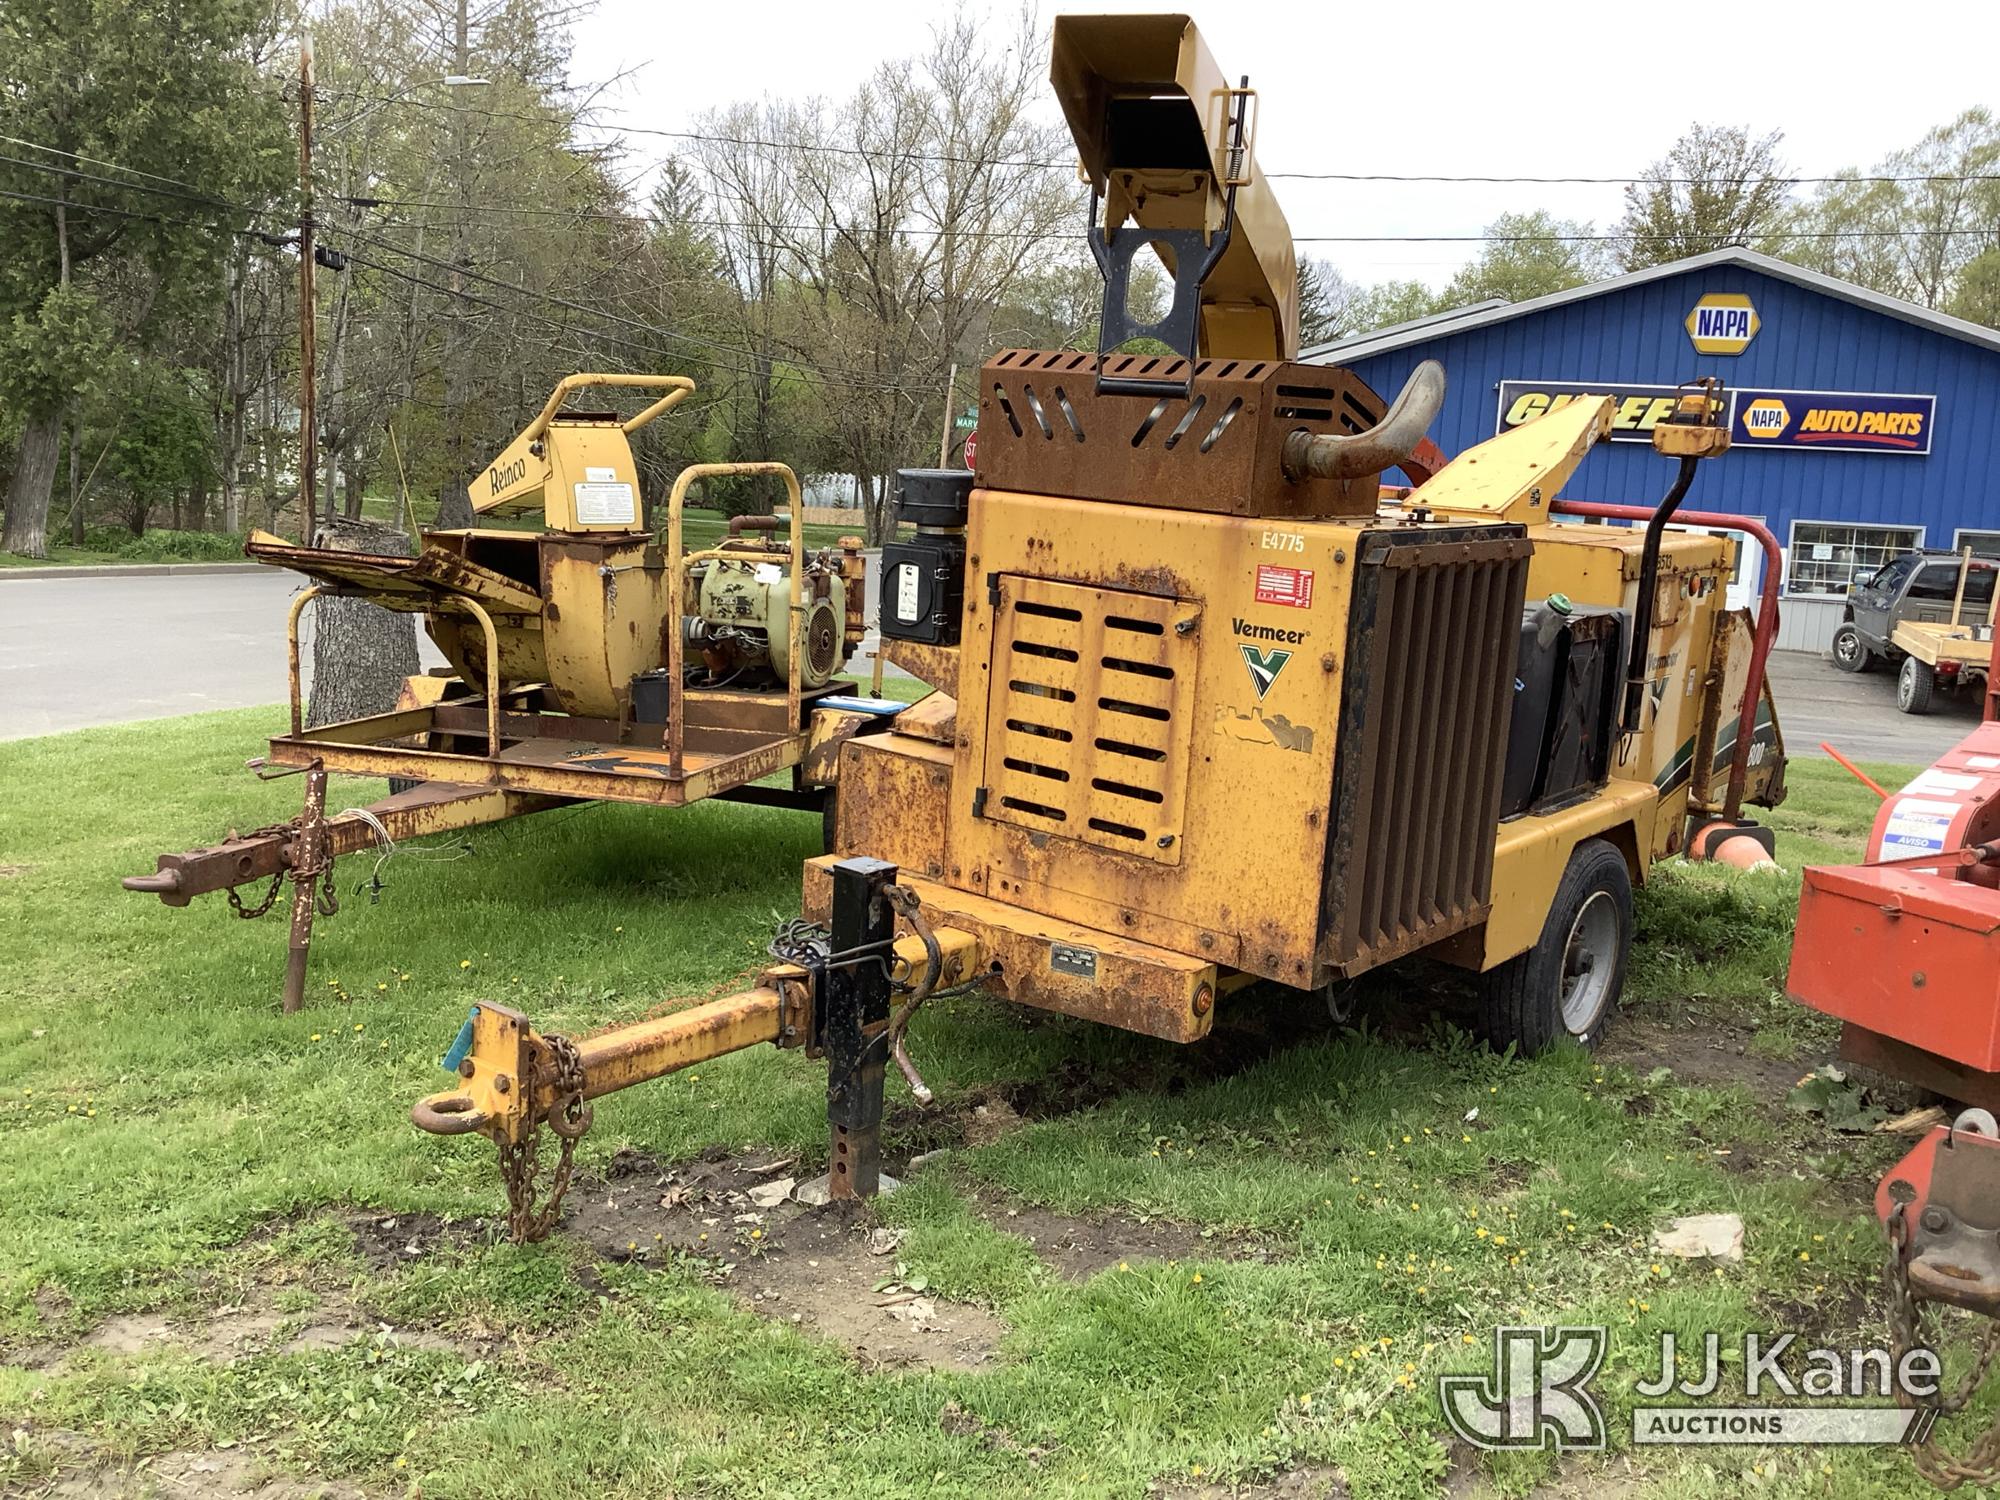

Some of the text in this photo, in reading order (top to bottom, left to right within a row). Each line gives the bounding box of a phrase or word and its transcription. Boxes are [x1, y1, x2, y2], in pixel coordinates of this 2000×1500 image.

[1697, 309, 1748, 337] NAPA
[1751, 409, 1782, 428] NAPA
[1800, 409, 1924, 436] AUTO PARTS
[966, 442, 977, 457] ST
[489, 458, 526, 496] Reinco
[1261, 531, 1305, 553] E4775
[1231, 617, 1306, 645] Vermeer
[1897, 836, 1929, 847] AVISO
